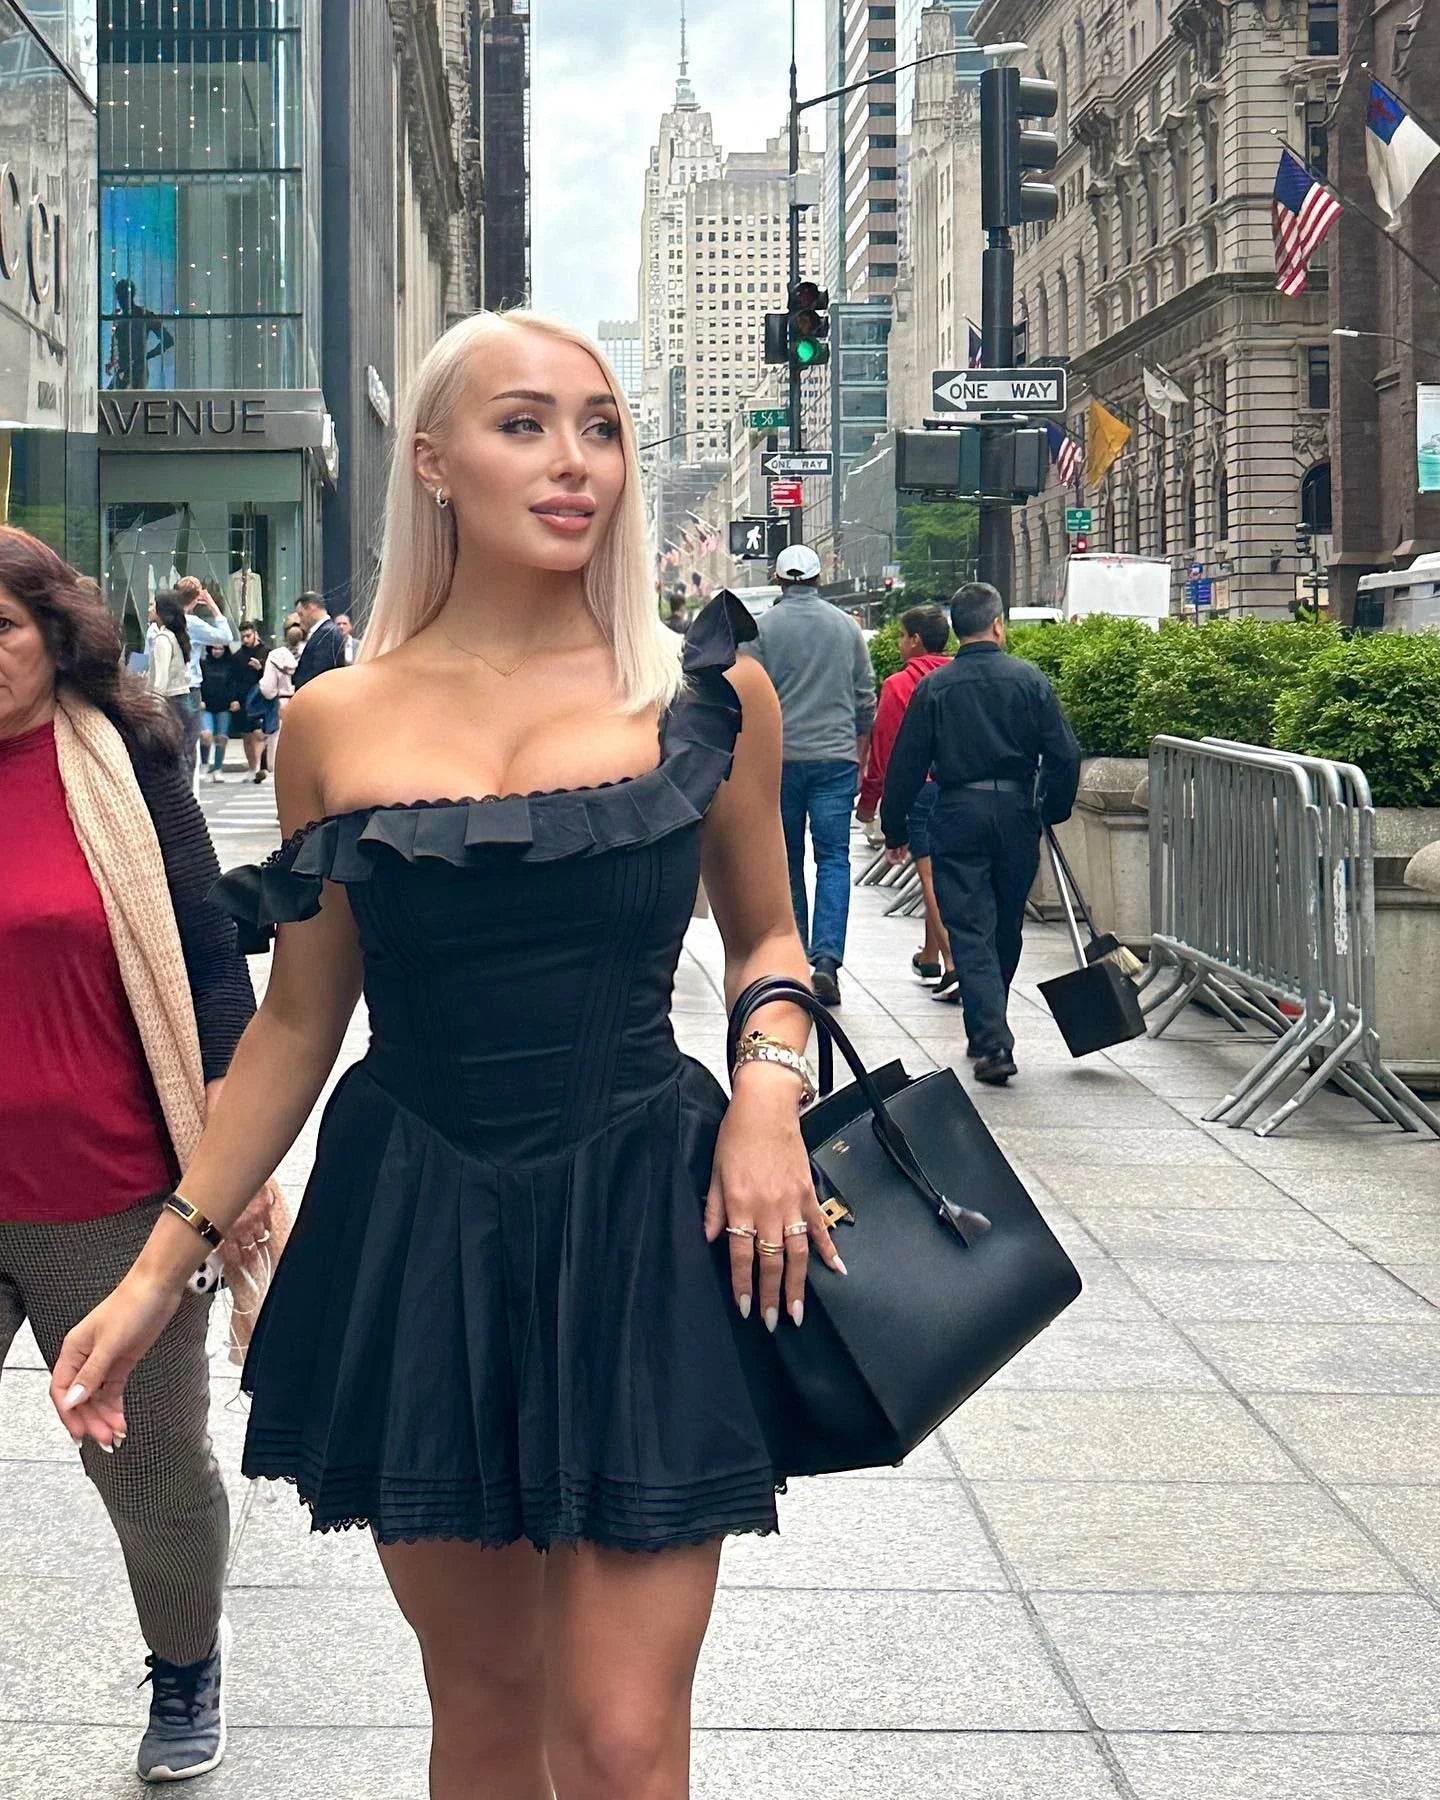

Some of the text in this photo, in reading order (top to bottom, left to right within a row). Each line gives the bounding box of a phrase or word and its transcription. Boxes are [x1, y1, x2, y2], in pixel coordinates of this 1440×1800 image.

[949, 383, 1053, 399] ONE WAY
[771, 459, 823, 469] ONE WAY
